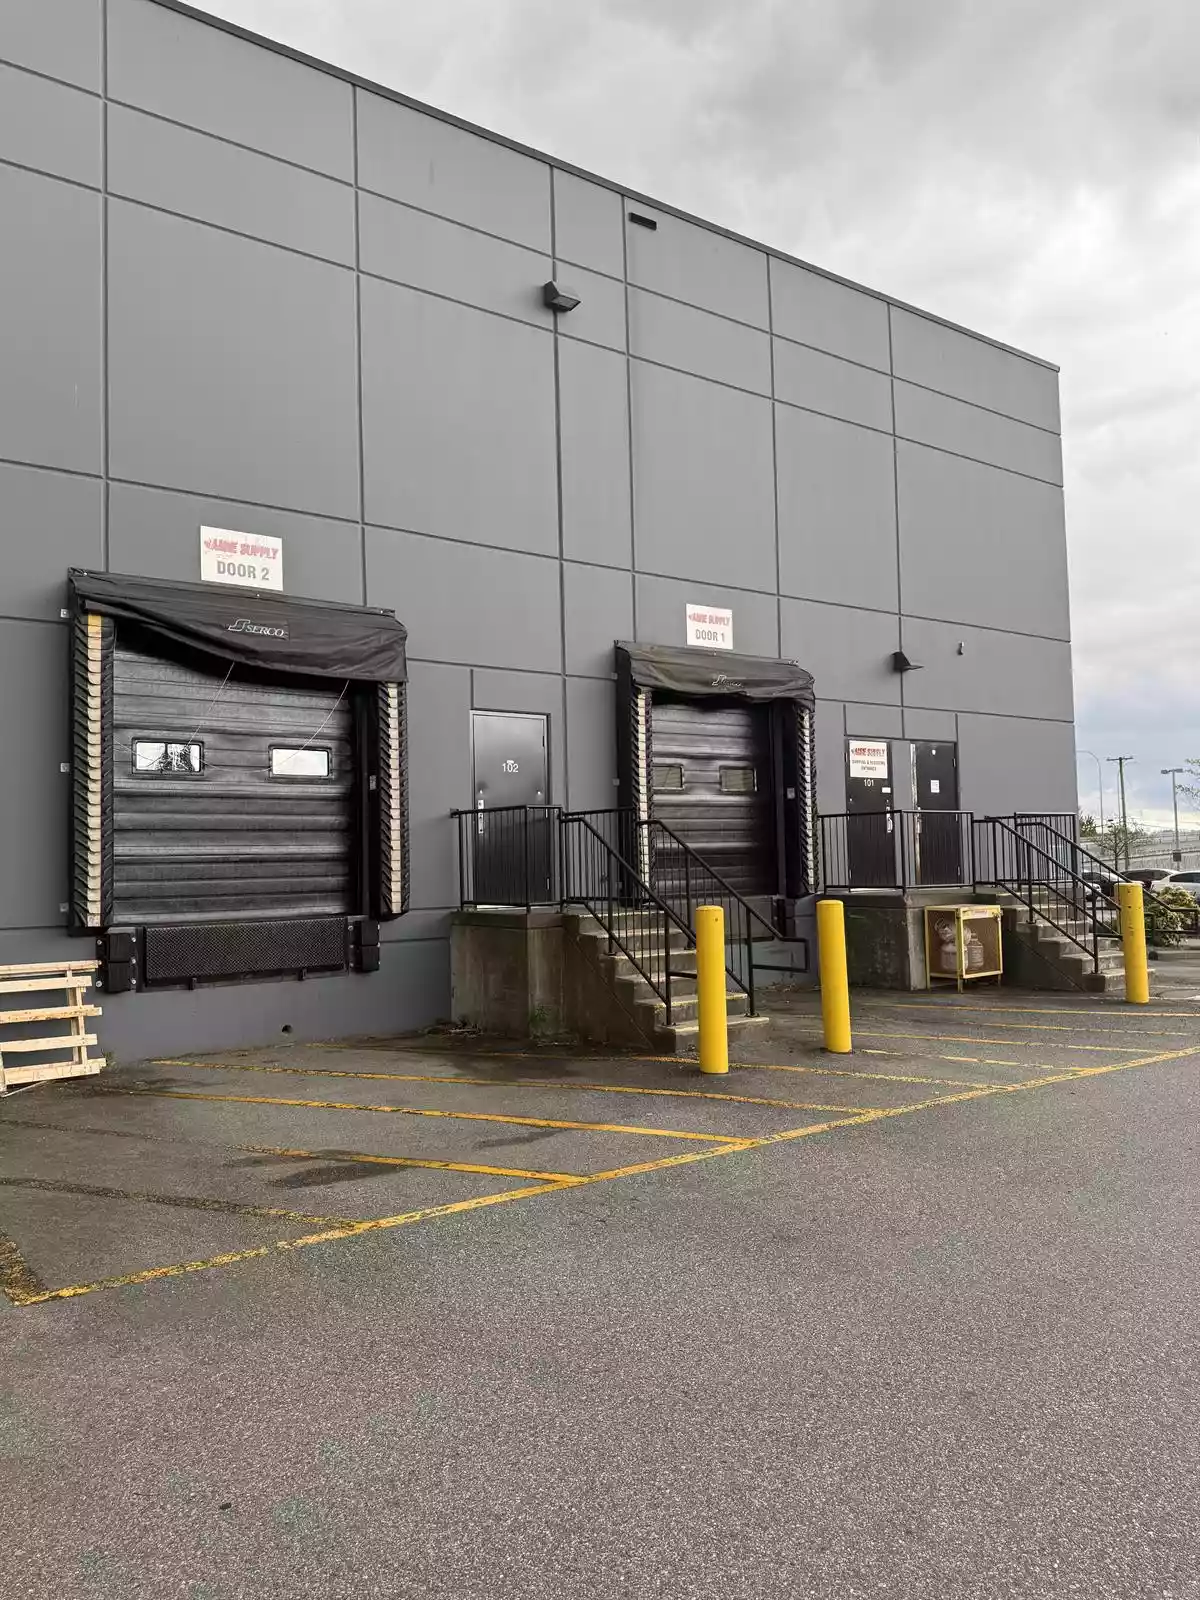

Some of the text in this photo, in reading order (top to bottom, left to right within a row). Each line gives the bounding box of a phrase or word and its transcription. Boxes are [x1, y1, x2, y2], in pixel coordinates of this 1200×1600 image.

[217, 560, 270, 581] DOOR 2
[245, 625, 285, 638] SERCO
[695, 629, 726, 643] DOOR 1
[502, 762, 519, 773] 102
[863, 779, 875, 787] 101
